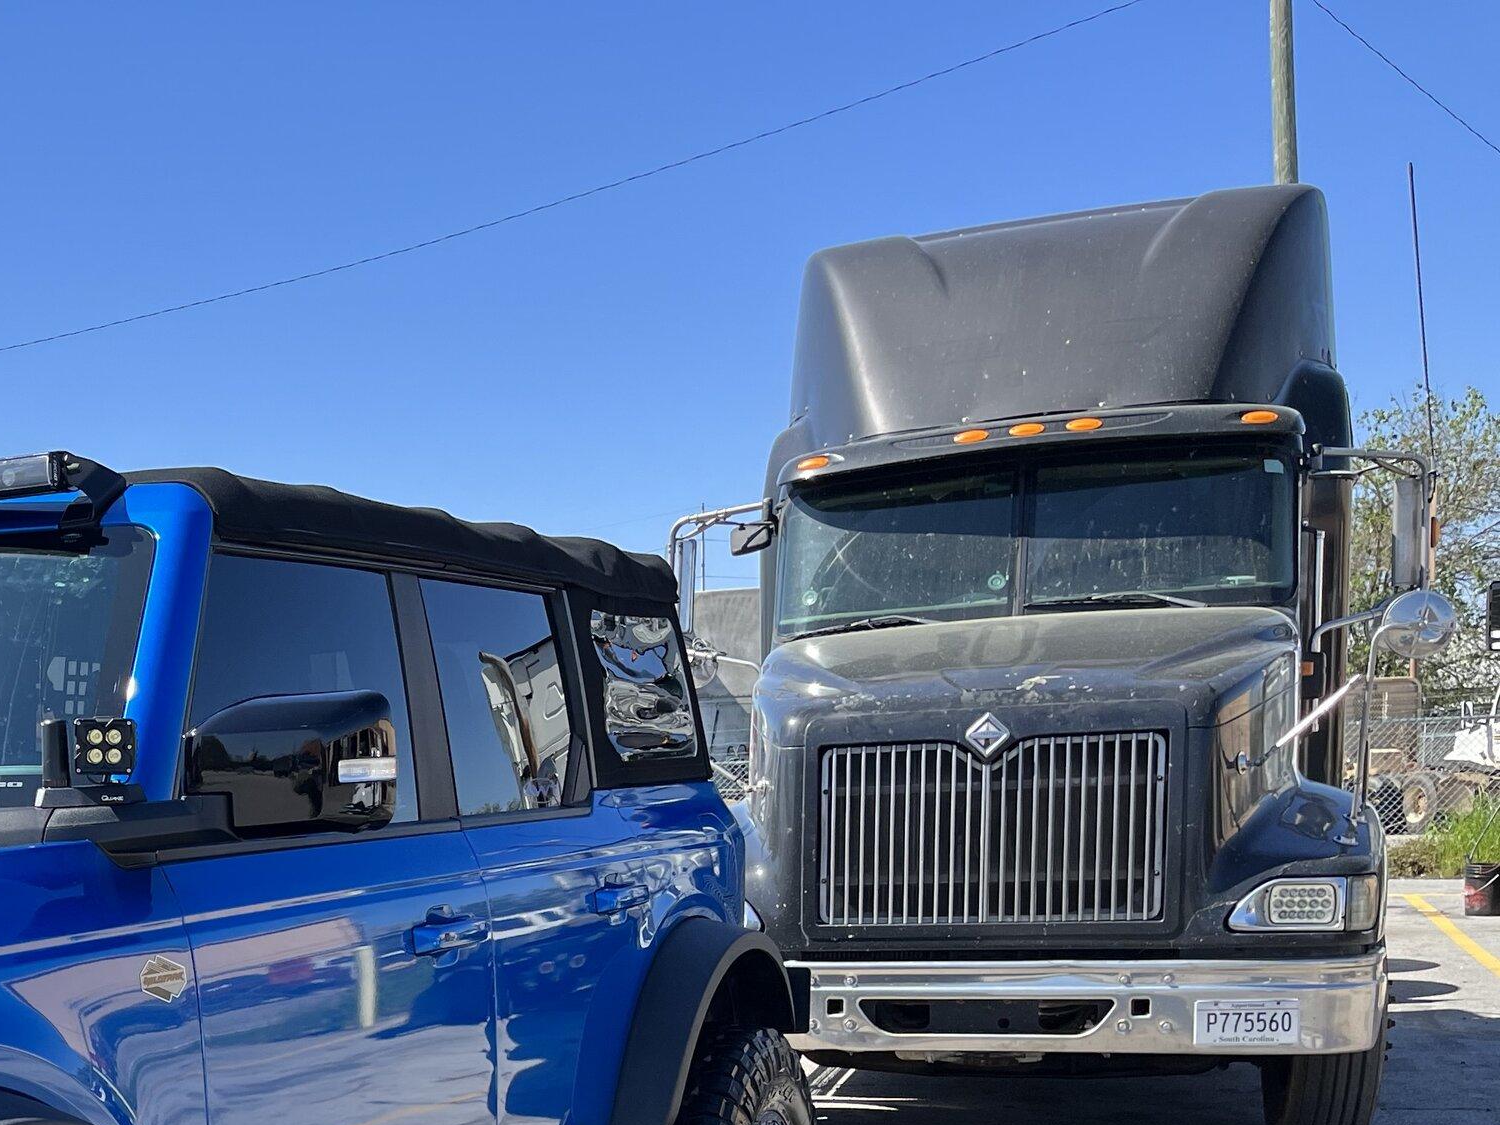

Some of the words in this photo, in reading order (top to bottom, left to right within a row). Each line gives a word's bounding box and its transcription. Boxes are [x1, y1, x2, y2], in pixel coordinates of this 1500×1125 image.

[1207, 1012, 1292, 1033] P775560
[1219, 1035, 1240, 1043] South
[1242, 1034, 1275, 1043] Carolina
